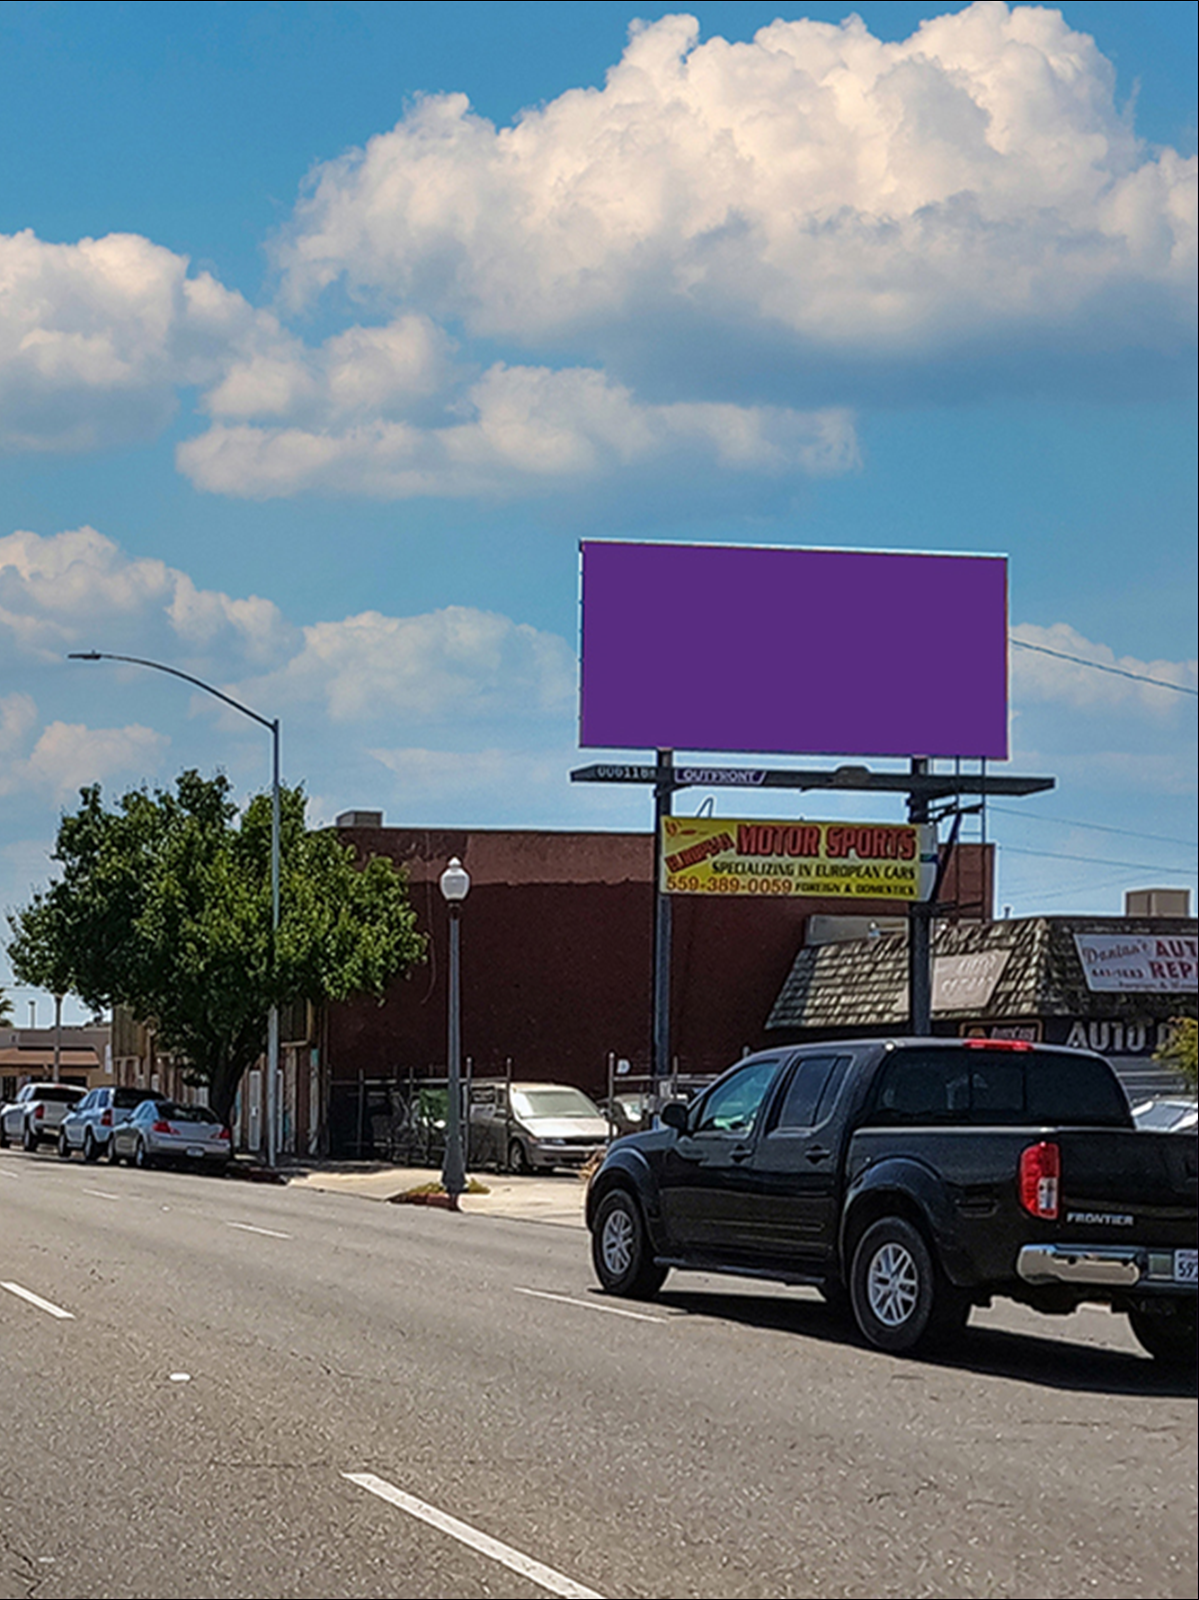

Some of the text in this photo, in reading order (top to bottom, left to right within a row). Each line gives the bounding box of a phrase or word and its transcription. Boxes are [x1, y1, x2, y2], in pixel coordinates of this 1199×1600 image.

[683, 769, 756, 784] OUTFRONT
[736, 824, 820, 857] MOTOR
[825, 825, 917, 860] SPORTS
[712, 861, 916, 881] SPECIALIZING IN EUROPEAN CARS
[666, 876, 794, 893] 559-389-0059
[1148, 961, 1198, 979] REP
[1066, 1020, 1146, 1052] AUTO
[1066, 1212, 1134, 1226] FRONTIER
